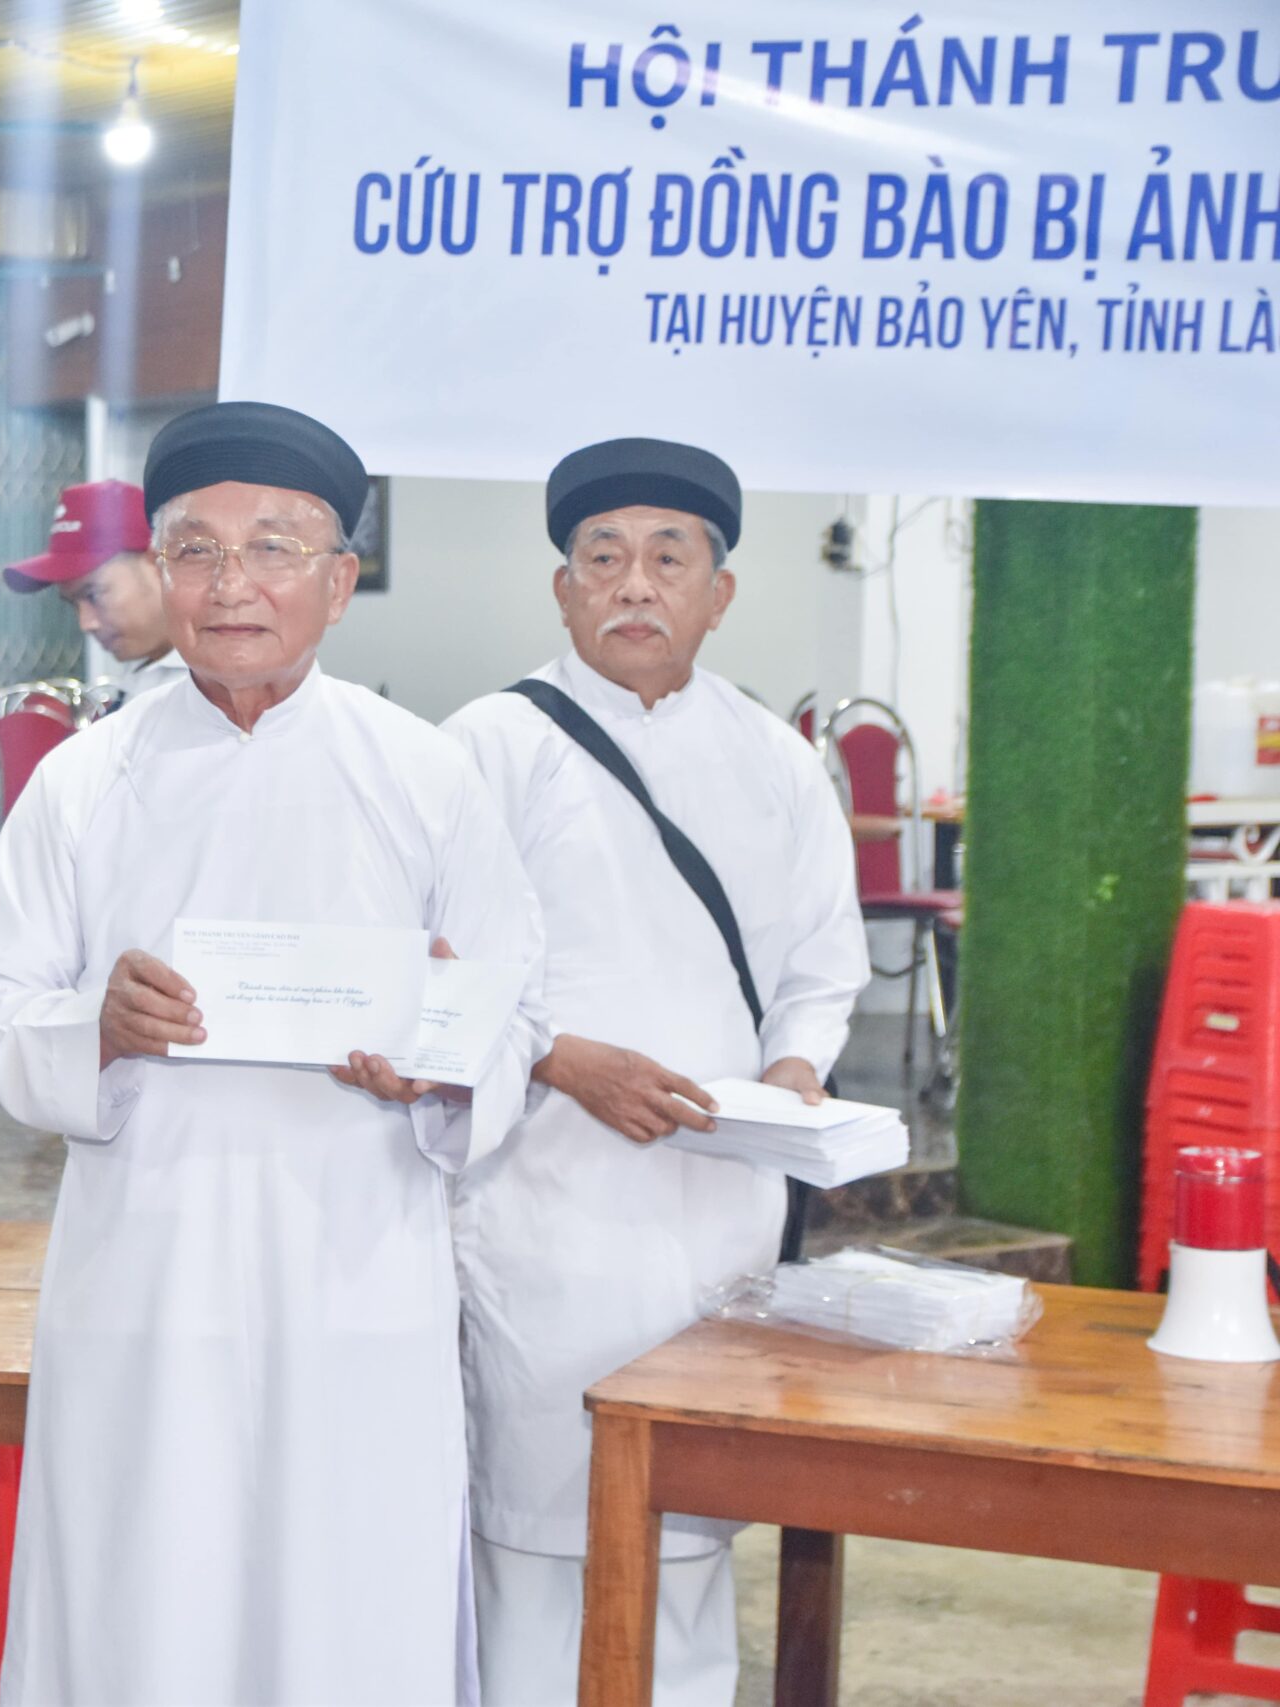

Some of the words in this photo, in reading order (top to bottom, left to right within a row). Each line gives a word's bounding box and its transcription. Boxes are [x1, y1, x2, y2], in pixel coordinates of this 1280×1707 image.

[568, 23, 721, 131] HỘI
[751, 13, 1072, 108] THÁNH
[1103, 29, 1280, 105] TRU
[353, 155, 481, 256] CỨU
[502, 166, 632, 276] TRỢ
[649, 146, 840, 260] ĐỒNG
[862, 155, 1010, 261] BÀO
[1031, 171, 1107, 283] BỊ
[1125, 143, 1280, 263] ẢNH
[644, 292, 707, 356] TẠI
[719, 284, 863, 358] HUYỆN
[875, 279, 966, 350] BẢO
[980, 287, 1080, 358] YÊN,
[1096, 280, 1206, 353] TỈNH
[1219, 287, 1280, 353] LÀ
